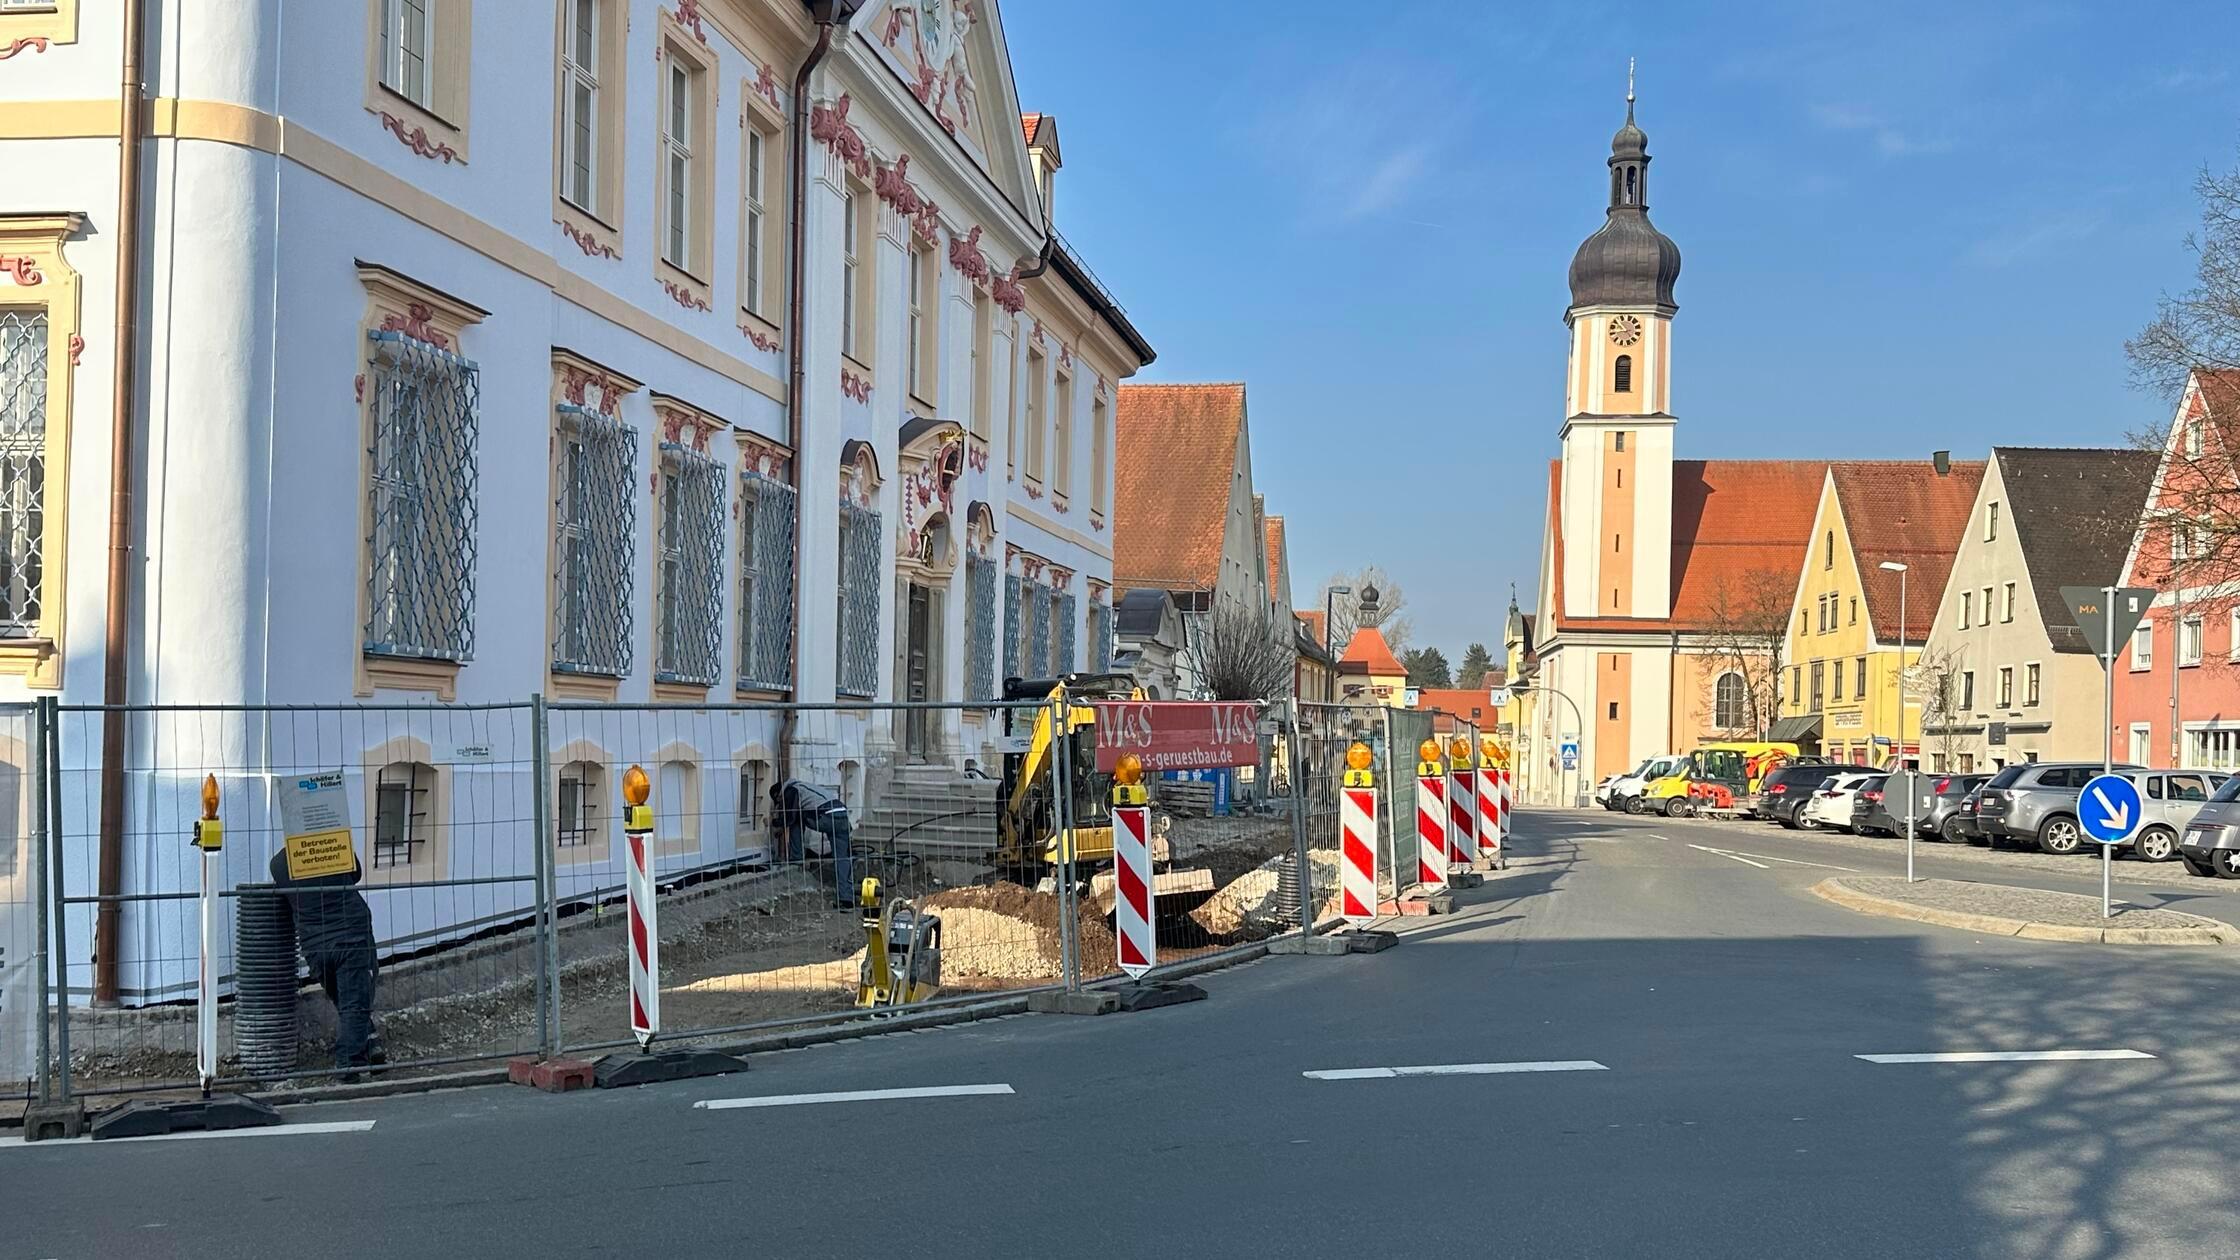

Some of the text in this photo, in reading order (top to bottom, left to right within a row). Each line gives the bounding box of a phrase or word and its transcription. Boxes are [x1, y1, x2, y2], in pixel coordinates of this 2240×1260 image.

[2079, 604, 2098, 614] MA
[1097, 705, 1153, 748] M&S
[1210, 705, 1256, 745] M&S
[301, 838, 337, 848] Betreten
[293, 844, 347, 858] der Baustelle
[302, 852, 340, 864] verboten!
